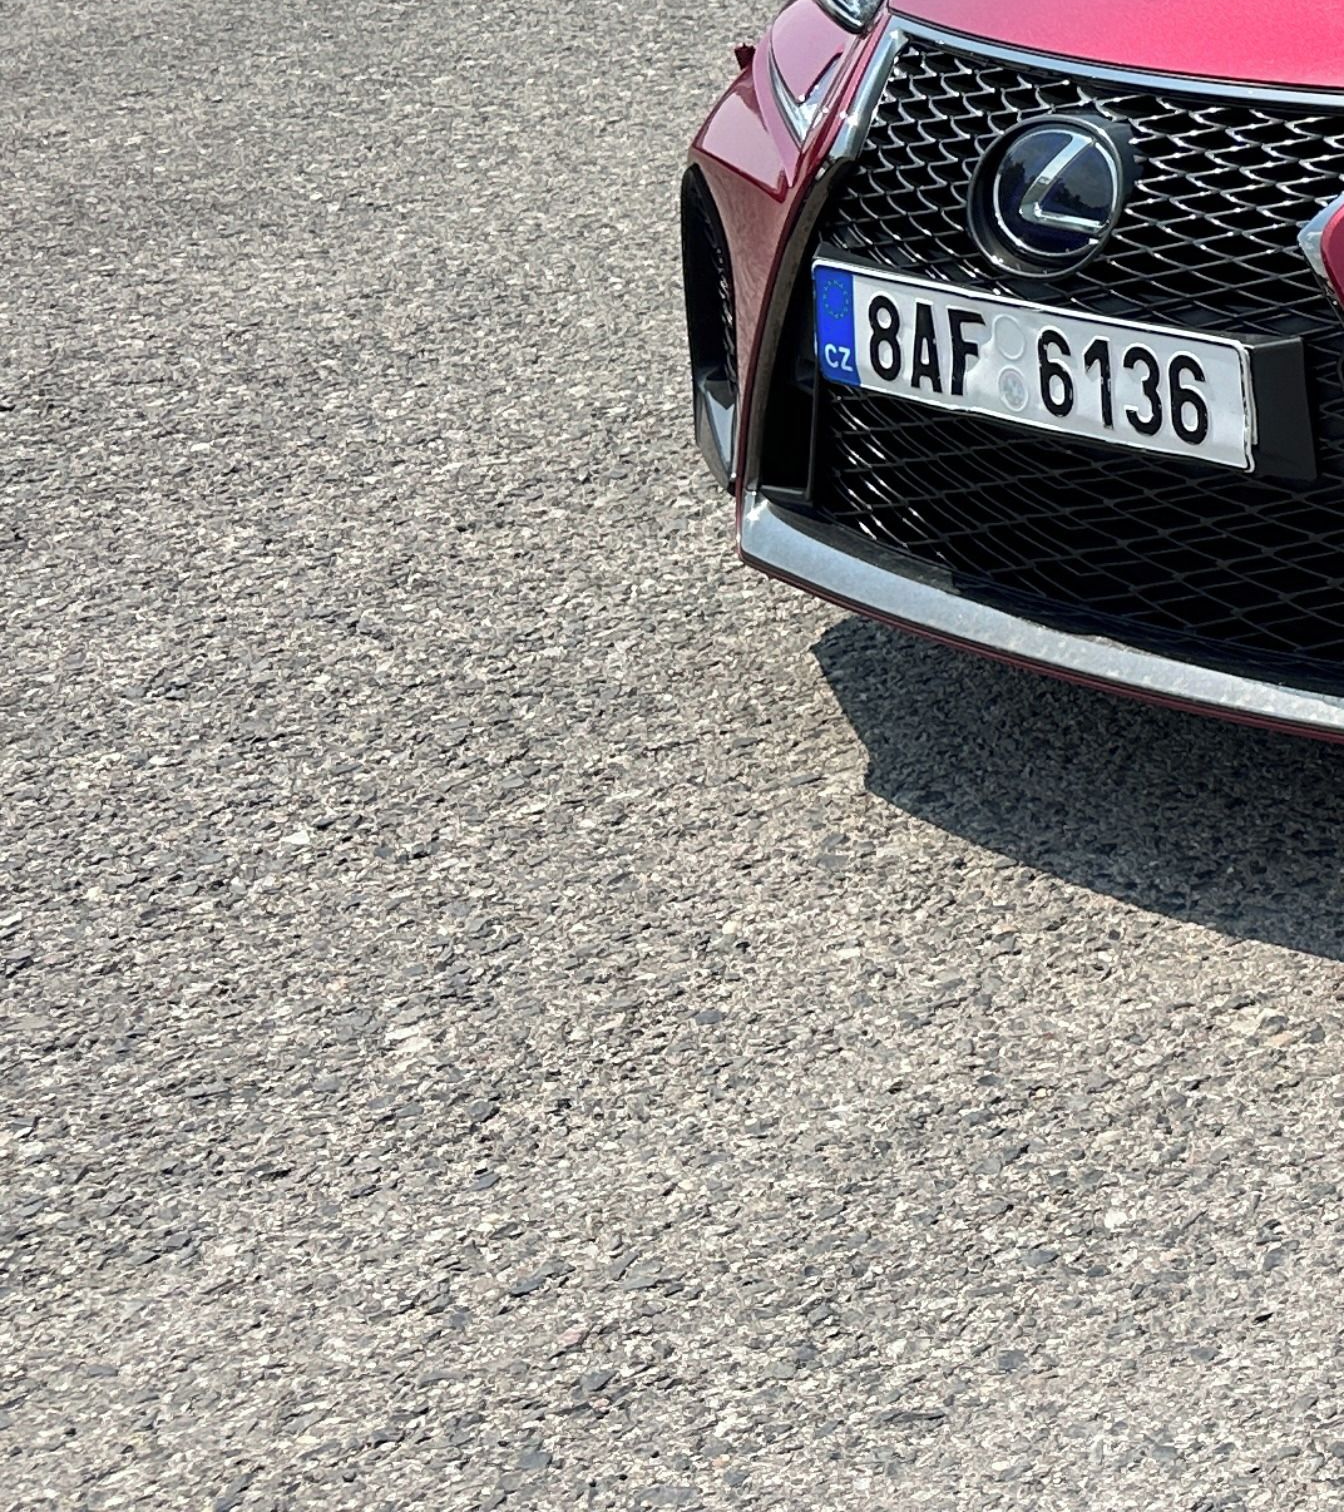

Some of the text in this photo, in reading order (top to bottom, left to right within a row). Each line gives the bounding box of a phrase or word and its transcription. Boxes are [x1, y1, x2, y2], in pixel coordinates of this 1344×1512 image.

[824, 292, 1208, 445] CZ 8AF 6136
